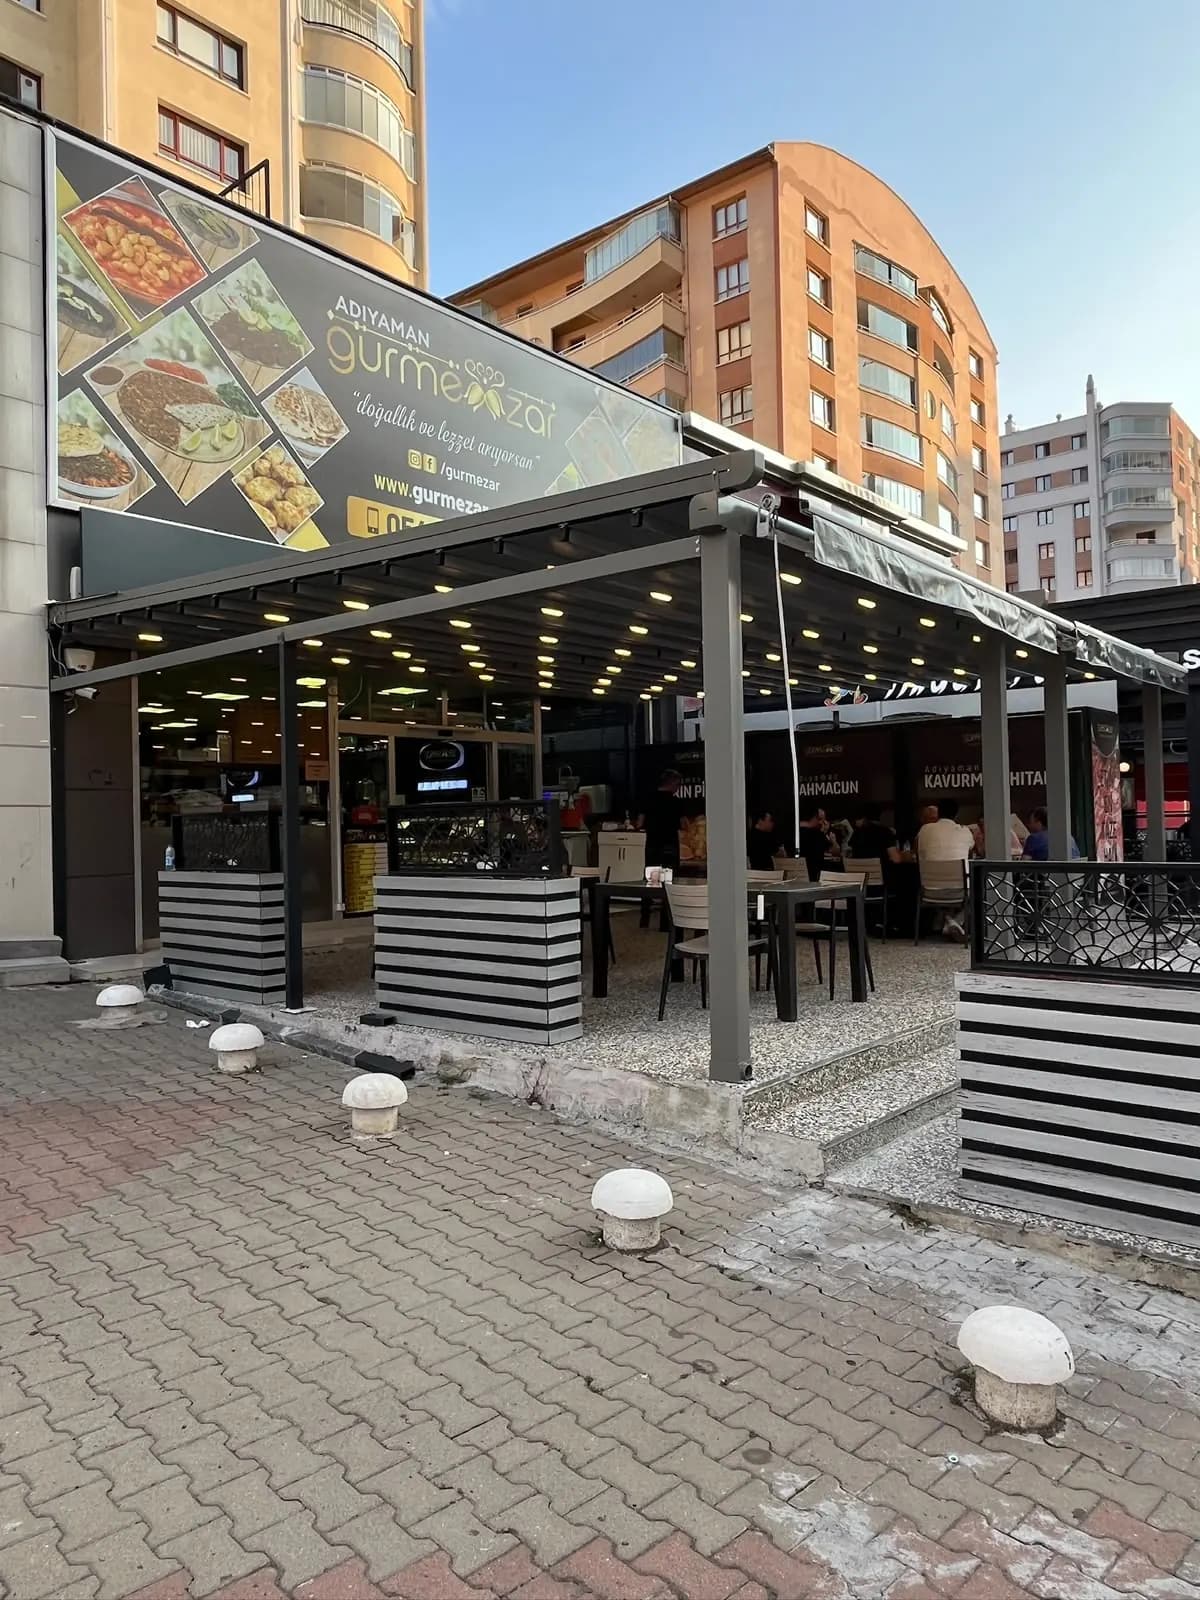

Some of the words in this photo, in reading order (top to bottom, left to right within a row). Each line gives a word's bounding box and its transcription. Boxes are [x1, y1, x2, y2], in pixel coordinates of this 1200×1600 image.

[334, 294, 431, 349] ADIYAMAN
[418, 420, 437, 438] ve
[437, 420, 475, 454] lezzet
[440, 461, 501, 492] /gurmezar
[799, 779, 859, 797] AHMACUN
[924, 772, 983, 789] KAVURM
[1010, 770, 1047, 787] HITA
